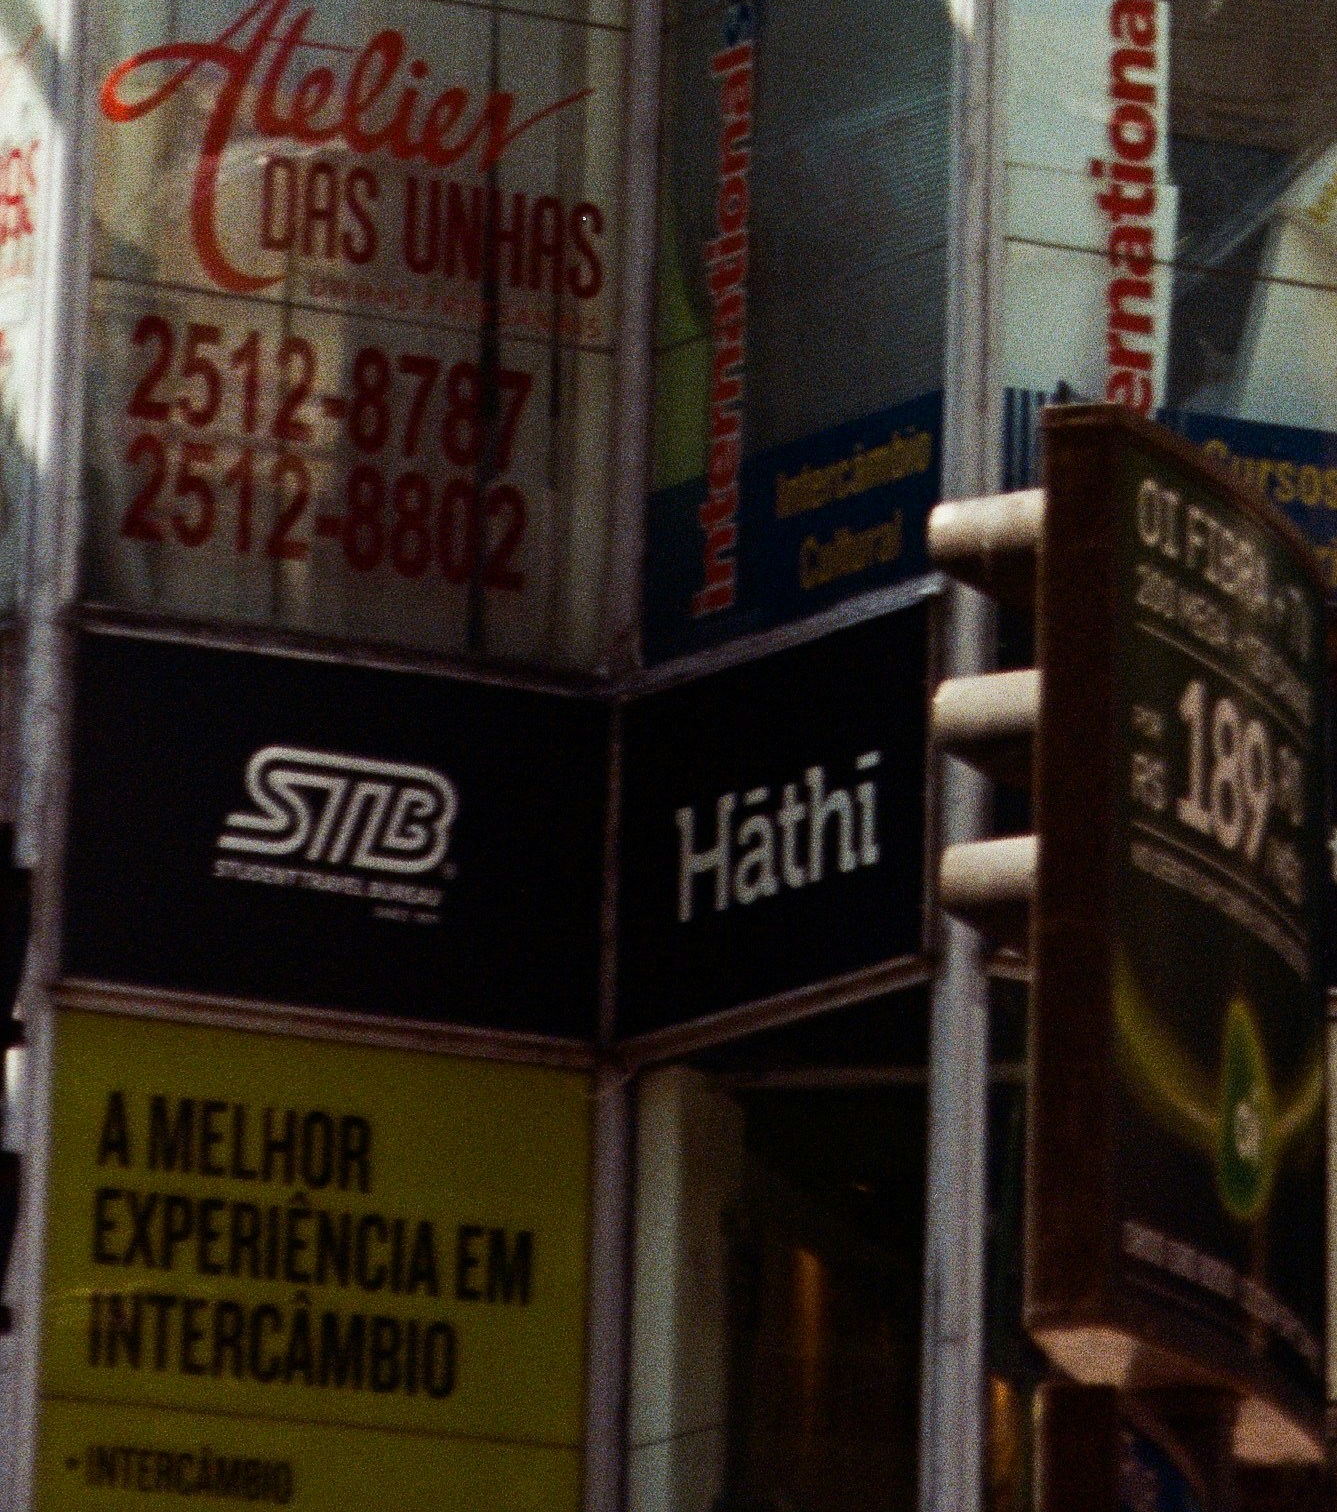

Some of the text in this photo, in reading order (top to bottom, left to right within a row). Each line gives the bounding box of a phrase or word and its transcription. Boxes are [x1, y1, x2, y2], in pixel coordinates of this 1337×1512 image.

[262, 155, 603, 299] DAS UNHAS
[126, 315, 533, 468] 2512-8787
[120, 434, 528, 590] 2512-8802
[215, 744, 461, 875] STB
[95, 1089, 372, 1194] A MELHOR
[93, 1186, 535, 1308] EXPERIÊNCIA EM
[88, 1290, 459, 1400] INTERCÂMBIO
